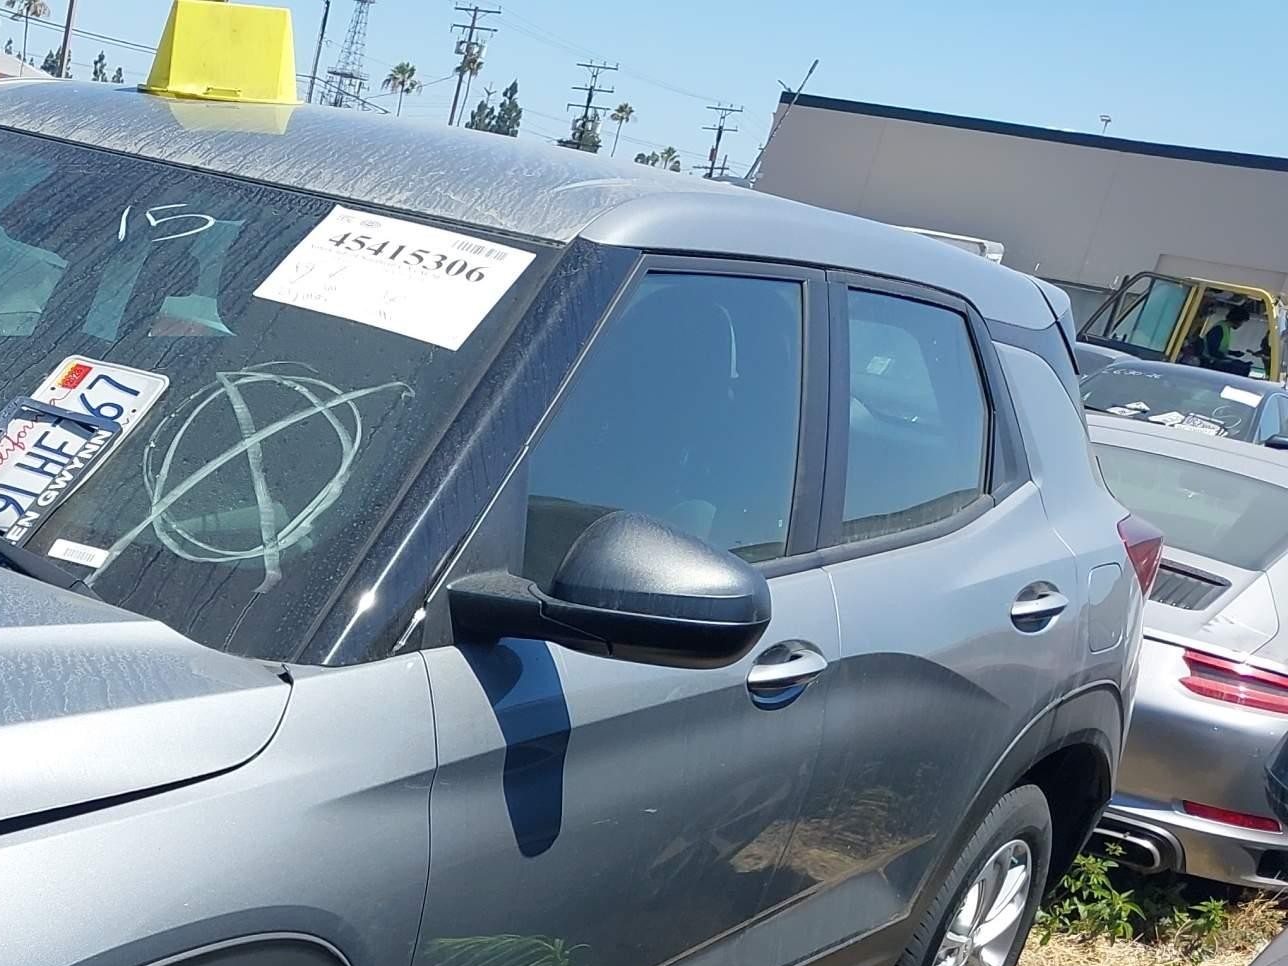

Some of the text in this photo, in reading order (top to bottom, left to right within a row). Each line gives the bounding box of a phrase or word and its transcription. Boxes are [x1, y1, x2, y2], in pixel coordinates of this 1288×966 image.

[118, 203, 216, 242] 15
[328, 231, 489, 283] 45415306
[37, 429, 114, 508] GWYNN
